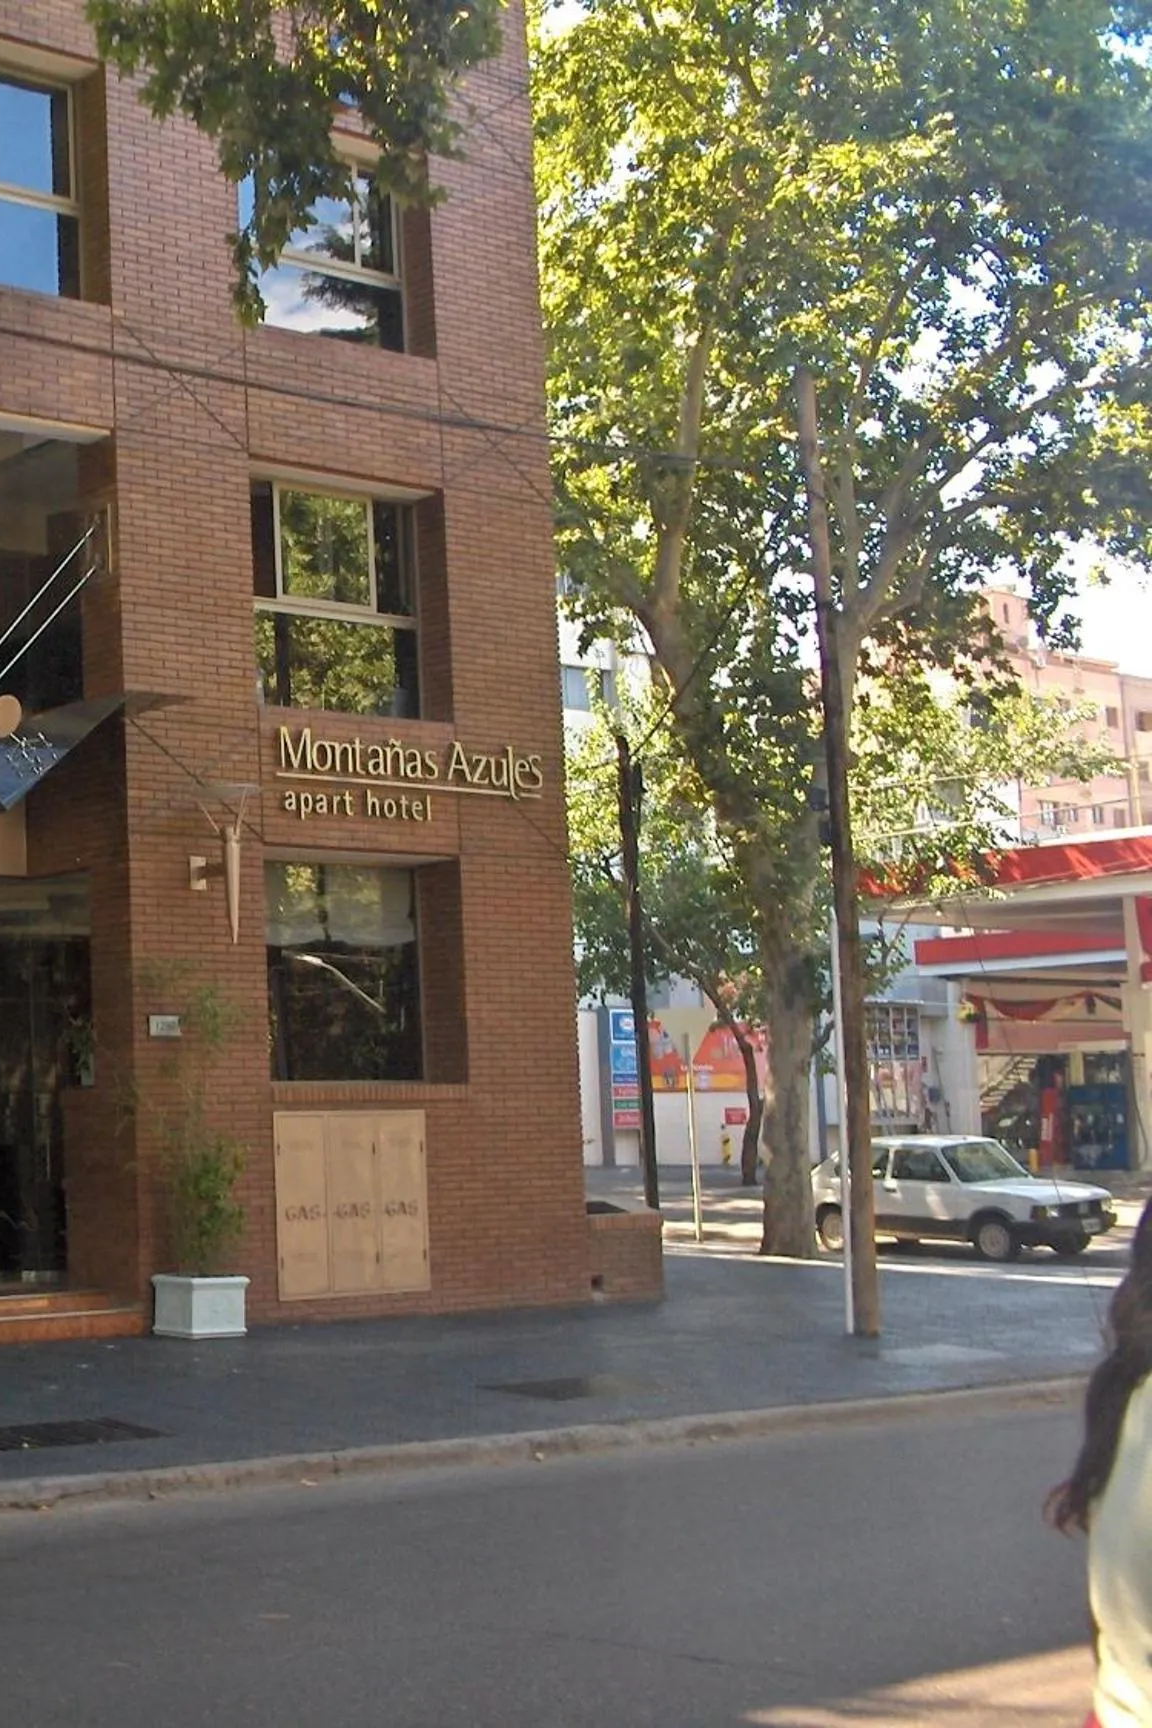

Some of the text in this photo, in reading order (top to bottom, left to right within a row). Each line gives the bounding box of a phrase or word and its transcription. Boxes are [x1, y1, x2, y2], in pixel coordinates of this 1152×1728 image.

[279, 726, 543, 799] Montañas Azules
[284, 788, 432, 821] apart hotel
[284, 1204, 321, 1222] GAS
[335, 1202, 371, 1219] GAS
[384, 1199, 419, 1217] GAS
